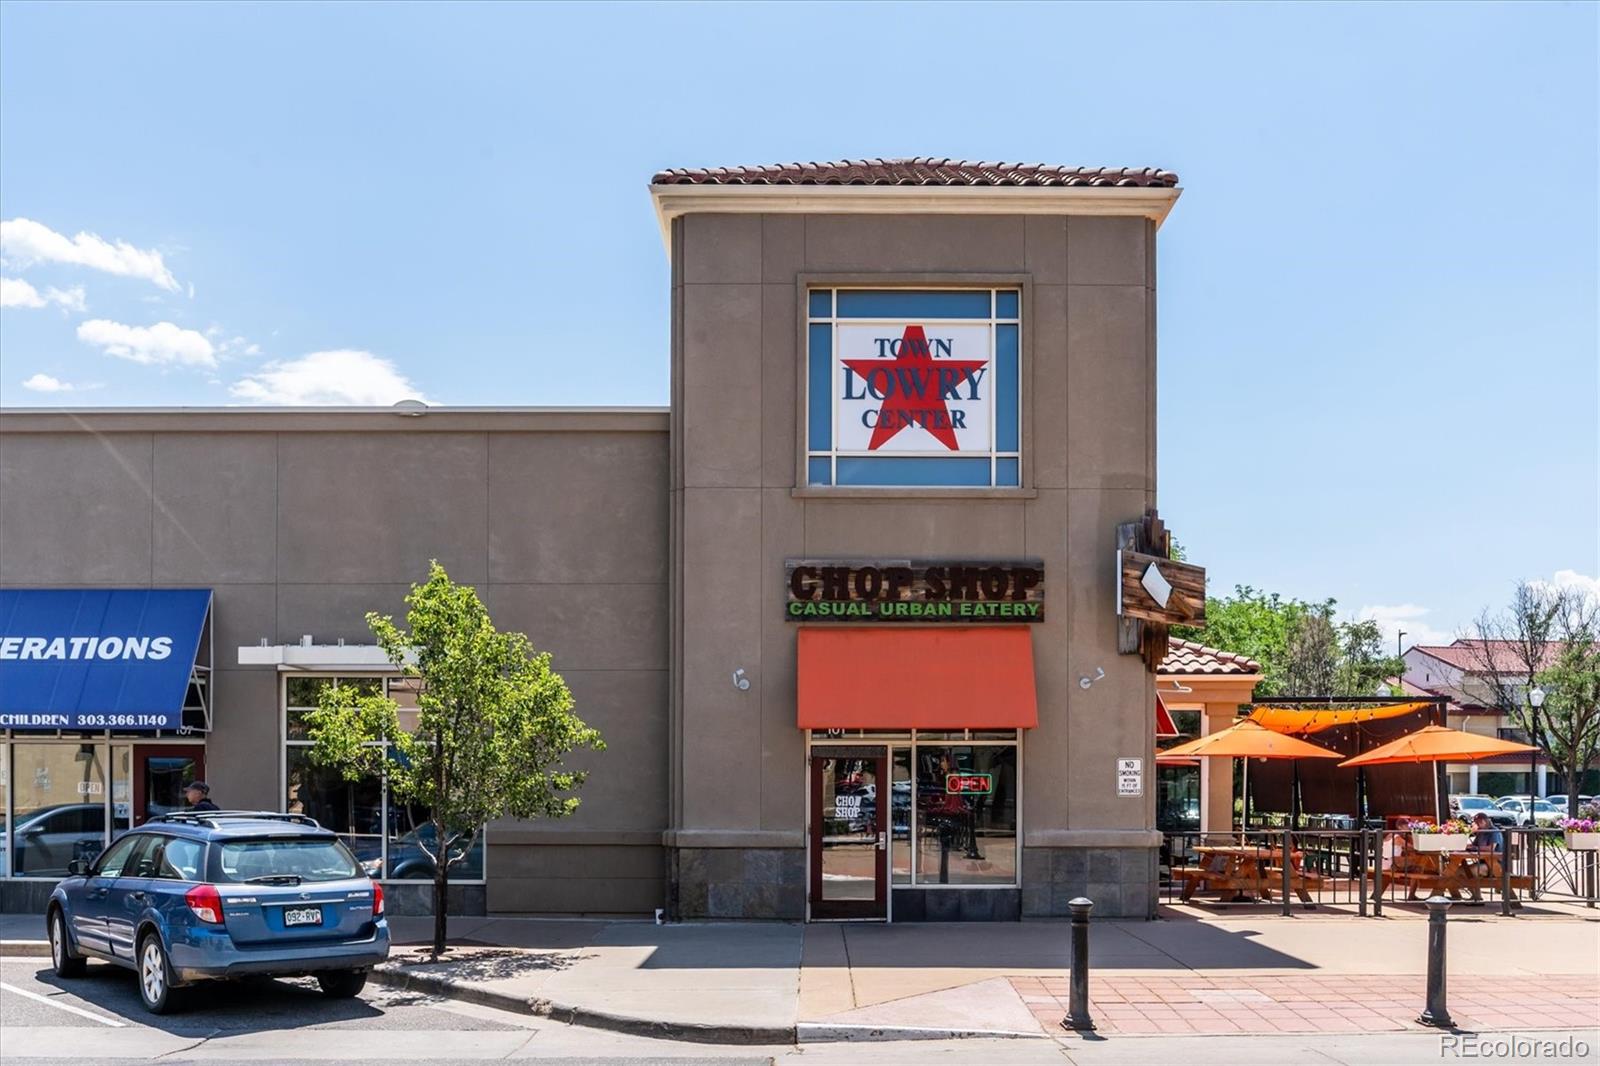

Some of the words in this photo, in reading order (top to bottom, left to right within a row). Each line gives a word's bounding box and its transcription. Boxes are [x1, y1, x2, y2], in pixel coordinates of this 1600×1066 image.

[874, 338, 953, 358] TOWN
[842, 367, 987, 401] LOWRY
[861, 409, 967, 429] CENTER
[790, 566, 913, 601] CHOP
[925, 566, 1040, 601] SHOP
[789, 602, 872, 616] CASUAL
[880, 602, 952, 616] URBAN
[960, 602, 1041, 616] EATERY
[0, 714, 69, 726] CHILDREN
[77, 714, 167, 726] 303.366.1140
[1125, 761, 1134, 769] NO
[80, 782, 100, 793] OPEN
[948, 776, 990, 792] OPEN
[835, 807, 861, 818] SHOP
